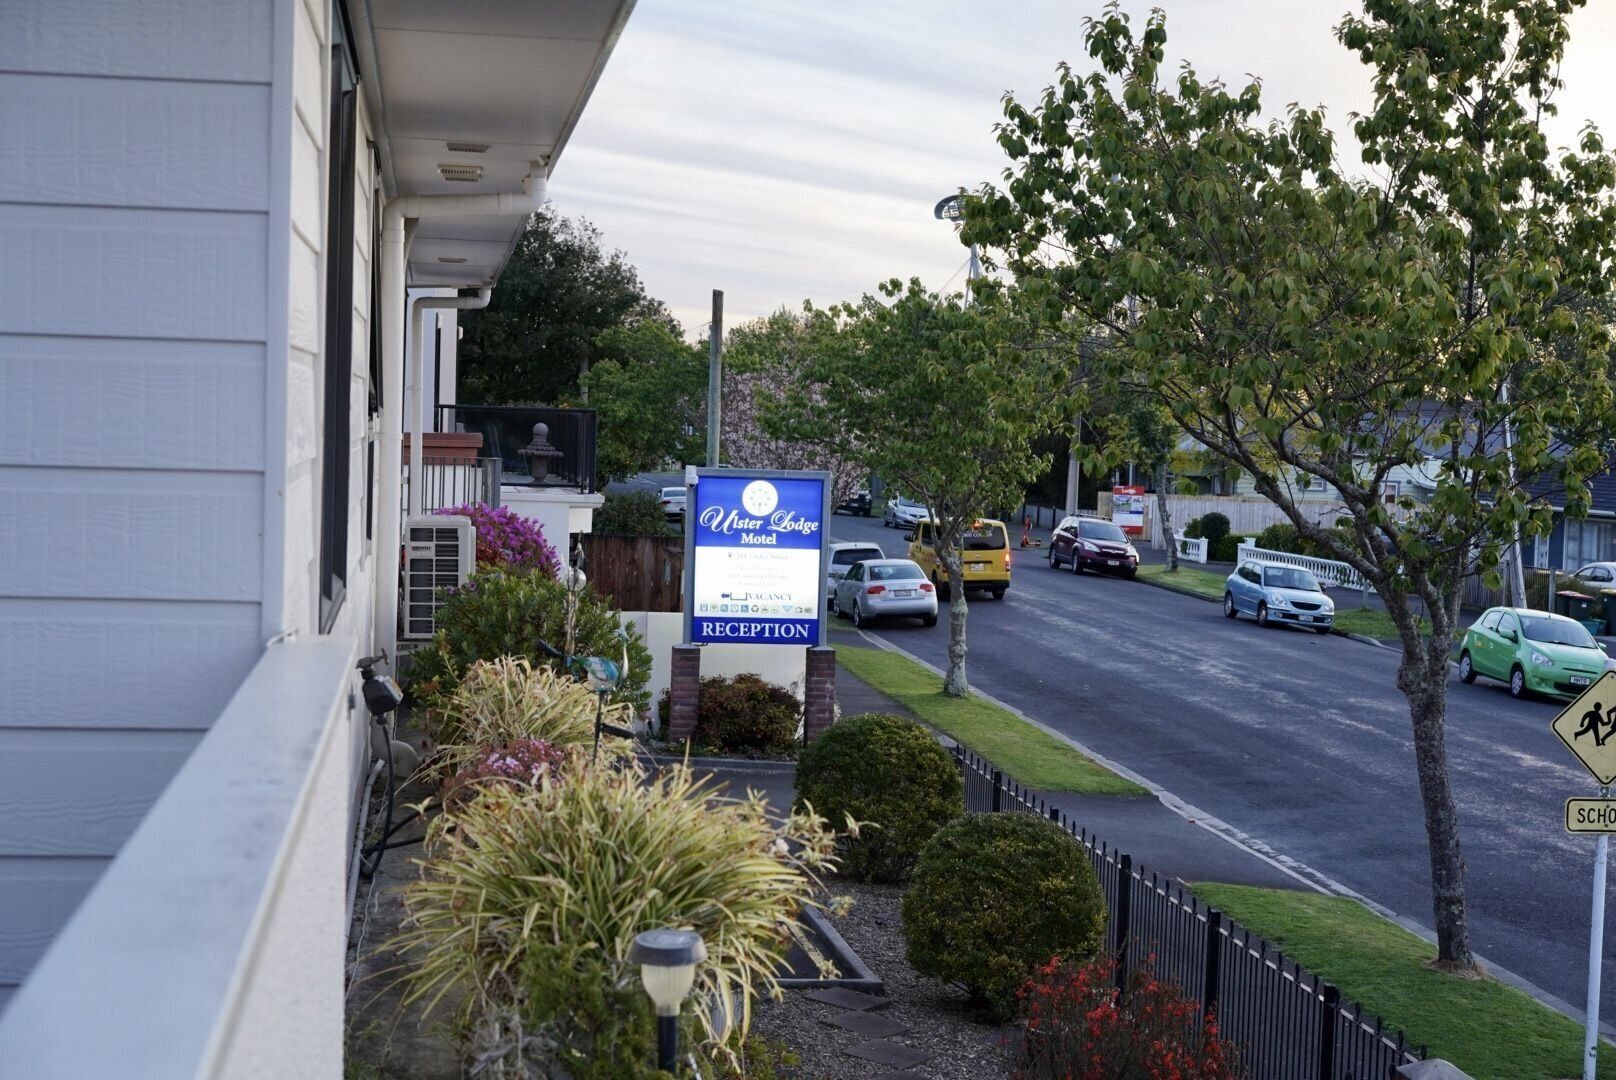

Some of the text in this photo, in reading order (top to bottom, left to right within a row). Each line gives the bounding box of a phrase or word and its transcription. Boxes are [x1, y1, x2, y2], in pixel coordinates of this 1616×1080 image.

[700, 506, 819, 535] Ulster Lodge
[740, 532, 777, 545] Motel
[748, 593, 793, 601] VACANCY
[701, 622, 810, 638] RECEPTION
[1577, 808, 1616, 823] SCHO
